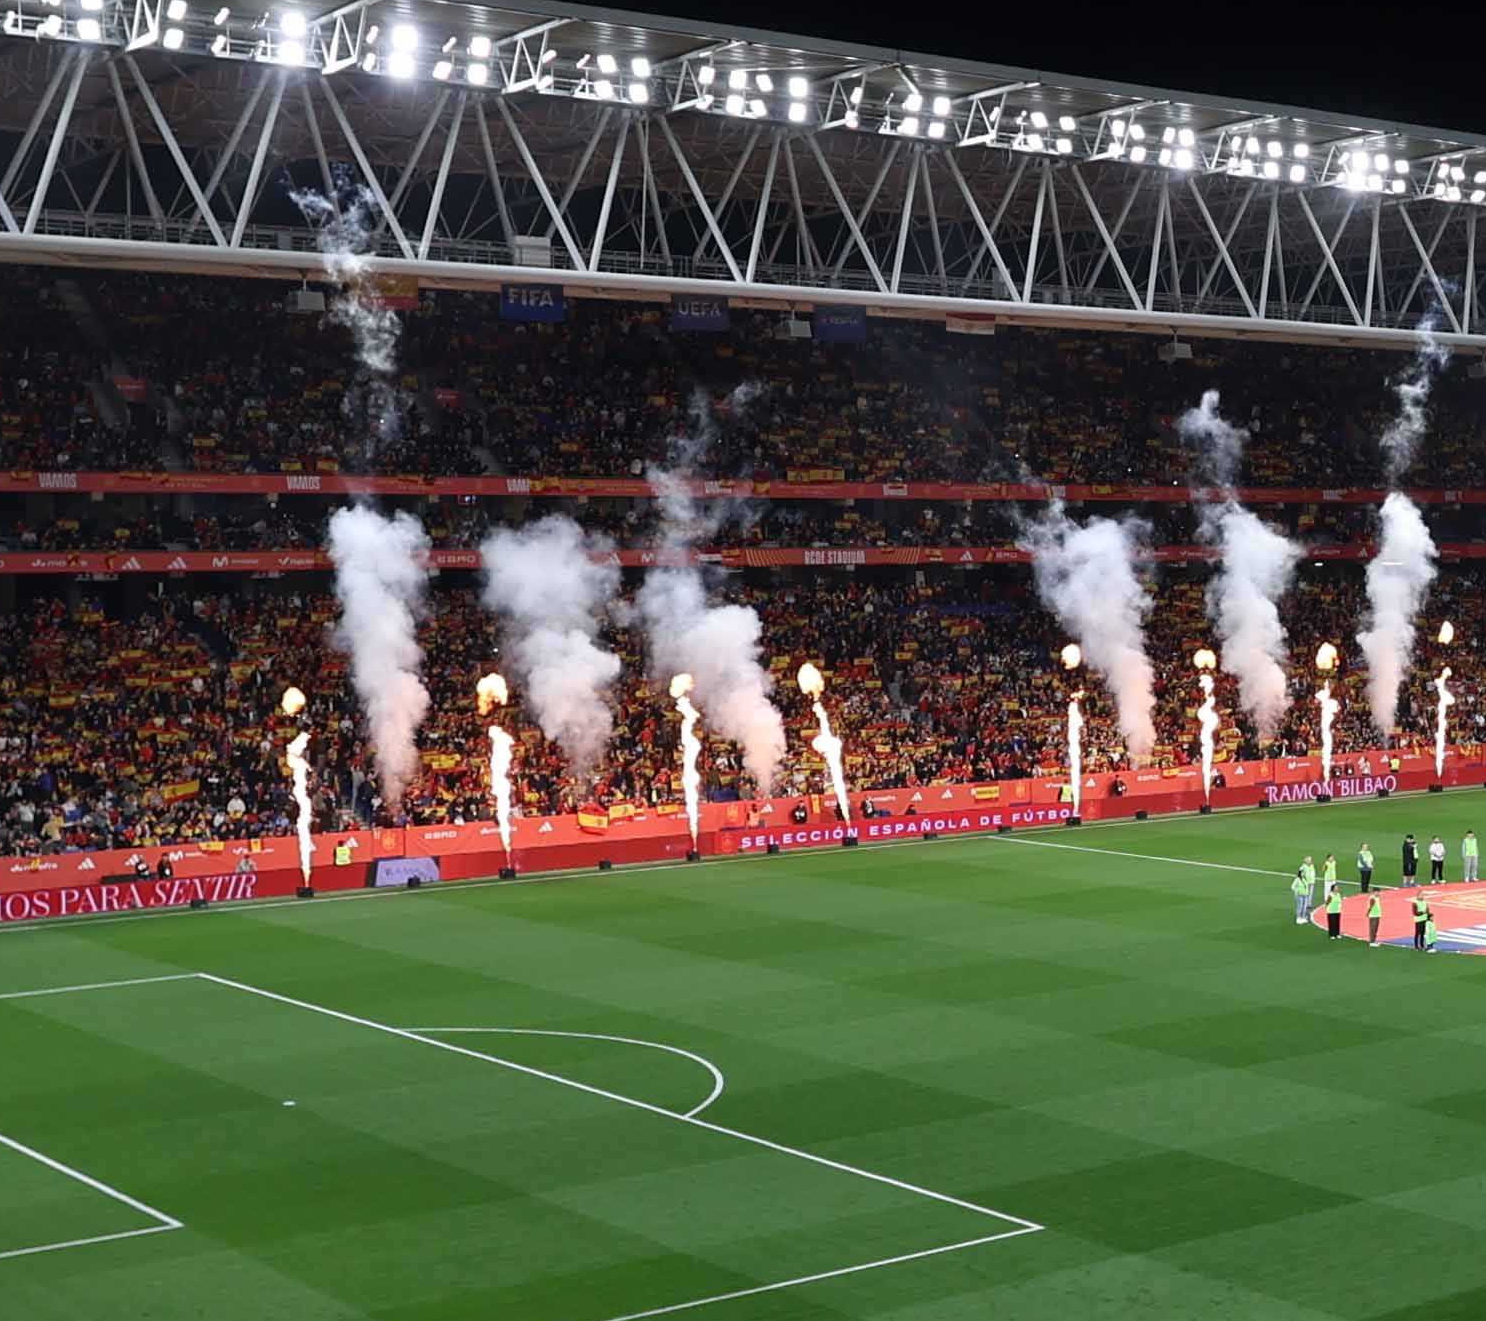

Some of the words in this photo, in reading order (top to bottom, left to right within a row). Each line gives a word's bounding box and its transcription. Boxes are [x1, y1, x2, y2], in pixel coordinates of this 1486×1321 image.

[508, 287, 554, 308] FIFA
[678, 300, 722, 317] UEFA
[38, 472, 78, 488] VAMOS
[1336, 775, 1398, 797] BILBAO
[740, 826, 859, 849] SELECCIÓN
[869, 816, 970, 837] ESPAÑOLA
[980, 813, 1003, 828] DE
[58, 882, 145, 915] PARA
[147, 873, 259, 907] SENTIR
